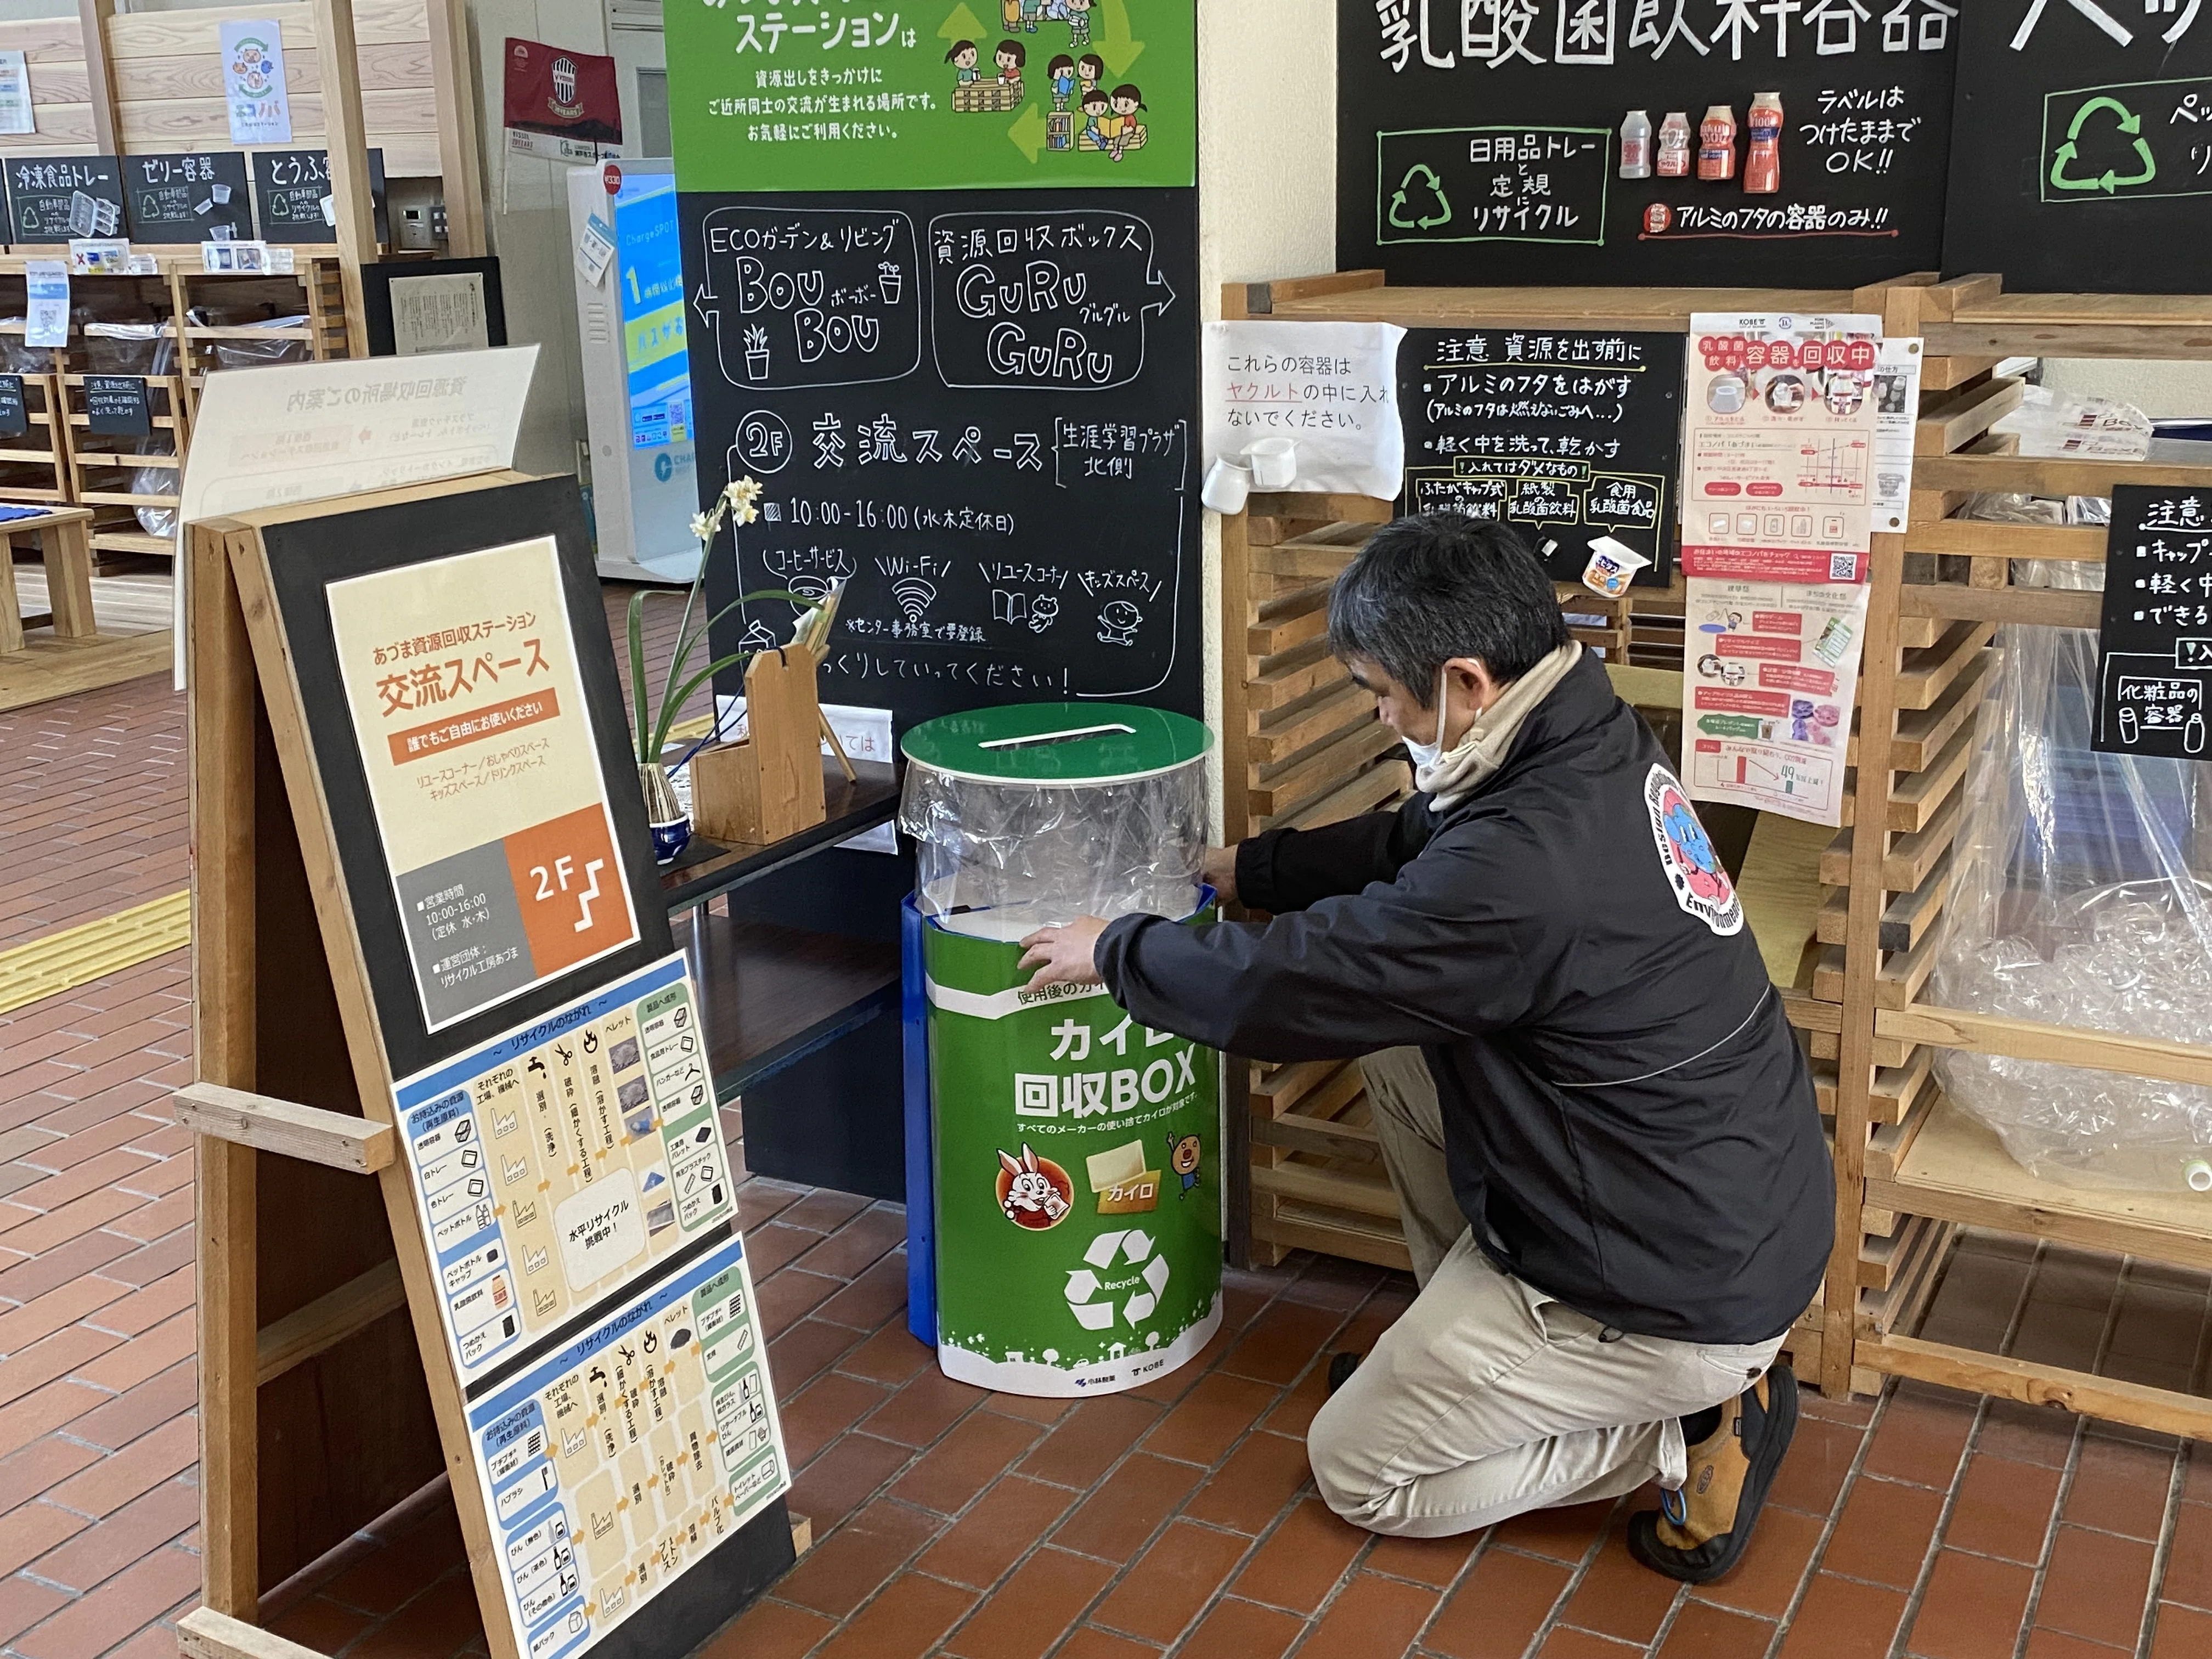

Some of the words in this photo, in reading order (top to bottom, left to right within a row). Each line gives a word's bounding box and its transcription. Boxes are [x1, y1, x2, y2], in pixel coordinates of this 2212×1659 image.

[736, 13, 916, 53] ステーションは
[755, 69, 883, 87] 資源出しをきっかけに
[708, 93, 937, 115] ご近所同士の交流が生まれる場所です。
[1818, 86, 1905, 115] ラベルは
[747, 122, 899, 142] お気軽にご利用ください。
[1799, 117, 1922, 146] つけたままで
[1469, 136, 1596, 164] 日用品トレー
[1826, 148, 1894, 174] OK!!
[16, 165, 108, 190] 冷凍食品トレー
[142, 156, 215, 183] ゼリー容器
[1517, 165, 1528, 176] と
[1490, 174, 1551, 198] 定規
[1473, 204, 1578, 232] リサイクル
[1677, 204, 1888, 231] アルミのフタの容器のみ!!
[626, 220, 675, 246] ChargeSPOT
[933, 224, 1143, 264] 資源回収ボックス
[1437, 335, 1489, 362] 注意
[1505, 332, 1642, 362] 資源を出す前に
[1702, 340, 1744, 352] 乳酸菌
[1746, 345, 1870, 367] 容器を回収中
[1228, 356, 1351, 375] これらの容器は
[1708, 356, 1737, 367] 飲料
[1227, 383, 1389, 403] ヤクルトの中に入れ
[1437, 373, 1632, 398] アルミのフタをはがす
[1228, 410, 1363, 430] ないでください。
[746, 422, 783, 458] 2F
[812, 413, 1043, 472] 交流スペース
[1063, 419, 1181, 456] 生涯学習プラザ
[1085, 459, 1132, 480] 北側
[1421, 479, 1504, 496] ふたがキャップ式
[1520, 482, 1556, 496] 紙製
[1606, 481, 1636, 498] 食用
[1509, 501, 1577, 516] 乳酸菌飲料
[1590, 499, 1655, 520] 乳酸菌食品
[2147, 495, 2204, 527] 注意
[776, 548, 853, 574] コーヒーサービス
[2152, 538, 2212, 564] キャップ
[886, 557, 939, 578] Wi-Fi
[990, 562, 1065, 589] リユースコーナー
[1084, 569, 1152, 593] キッズスペース
[373, 611, 536, 665] あづま資源回収ステーション
[376, 639, 549, 718] 交流スペース
[822, 653, 1070, 693] っくりしていってください!
[2121, 682, 2199, 703] 化粧品の
[407, 701, 543, 753] 誰でもご自由にお使いください
[2144, 704, 2183, 724] 容器
[529, 855, 574, 902] 2F
[424, 883, 464, 911] 営業時間
[426, 893, 487, 926] 10:00-16:00
[441, 946, 519, 989] リサイクル工房あづま
[511, 1005, 591, 1051] リサイクルのながれ
[477, 1068, 513, 1091] それぞれの
[1015, 1042, 1196, 1118] 回収BOX
[424, 1165, 447, 1180] 白トレー
[1107, 1183, 1154, 1203] カイロ
[568, 1200, 629, 1243] 水平リサイクル
[1104, 1276, 1140, 1291] Recycle
[577, 1301, 653, 1356] リサイクルのながれ
[1143, 1359, 1165, 1373] KOBE
